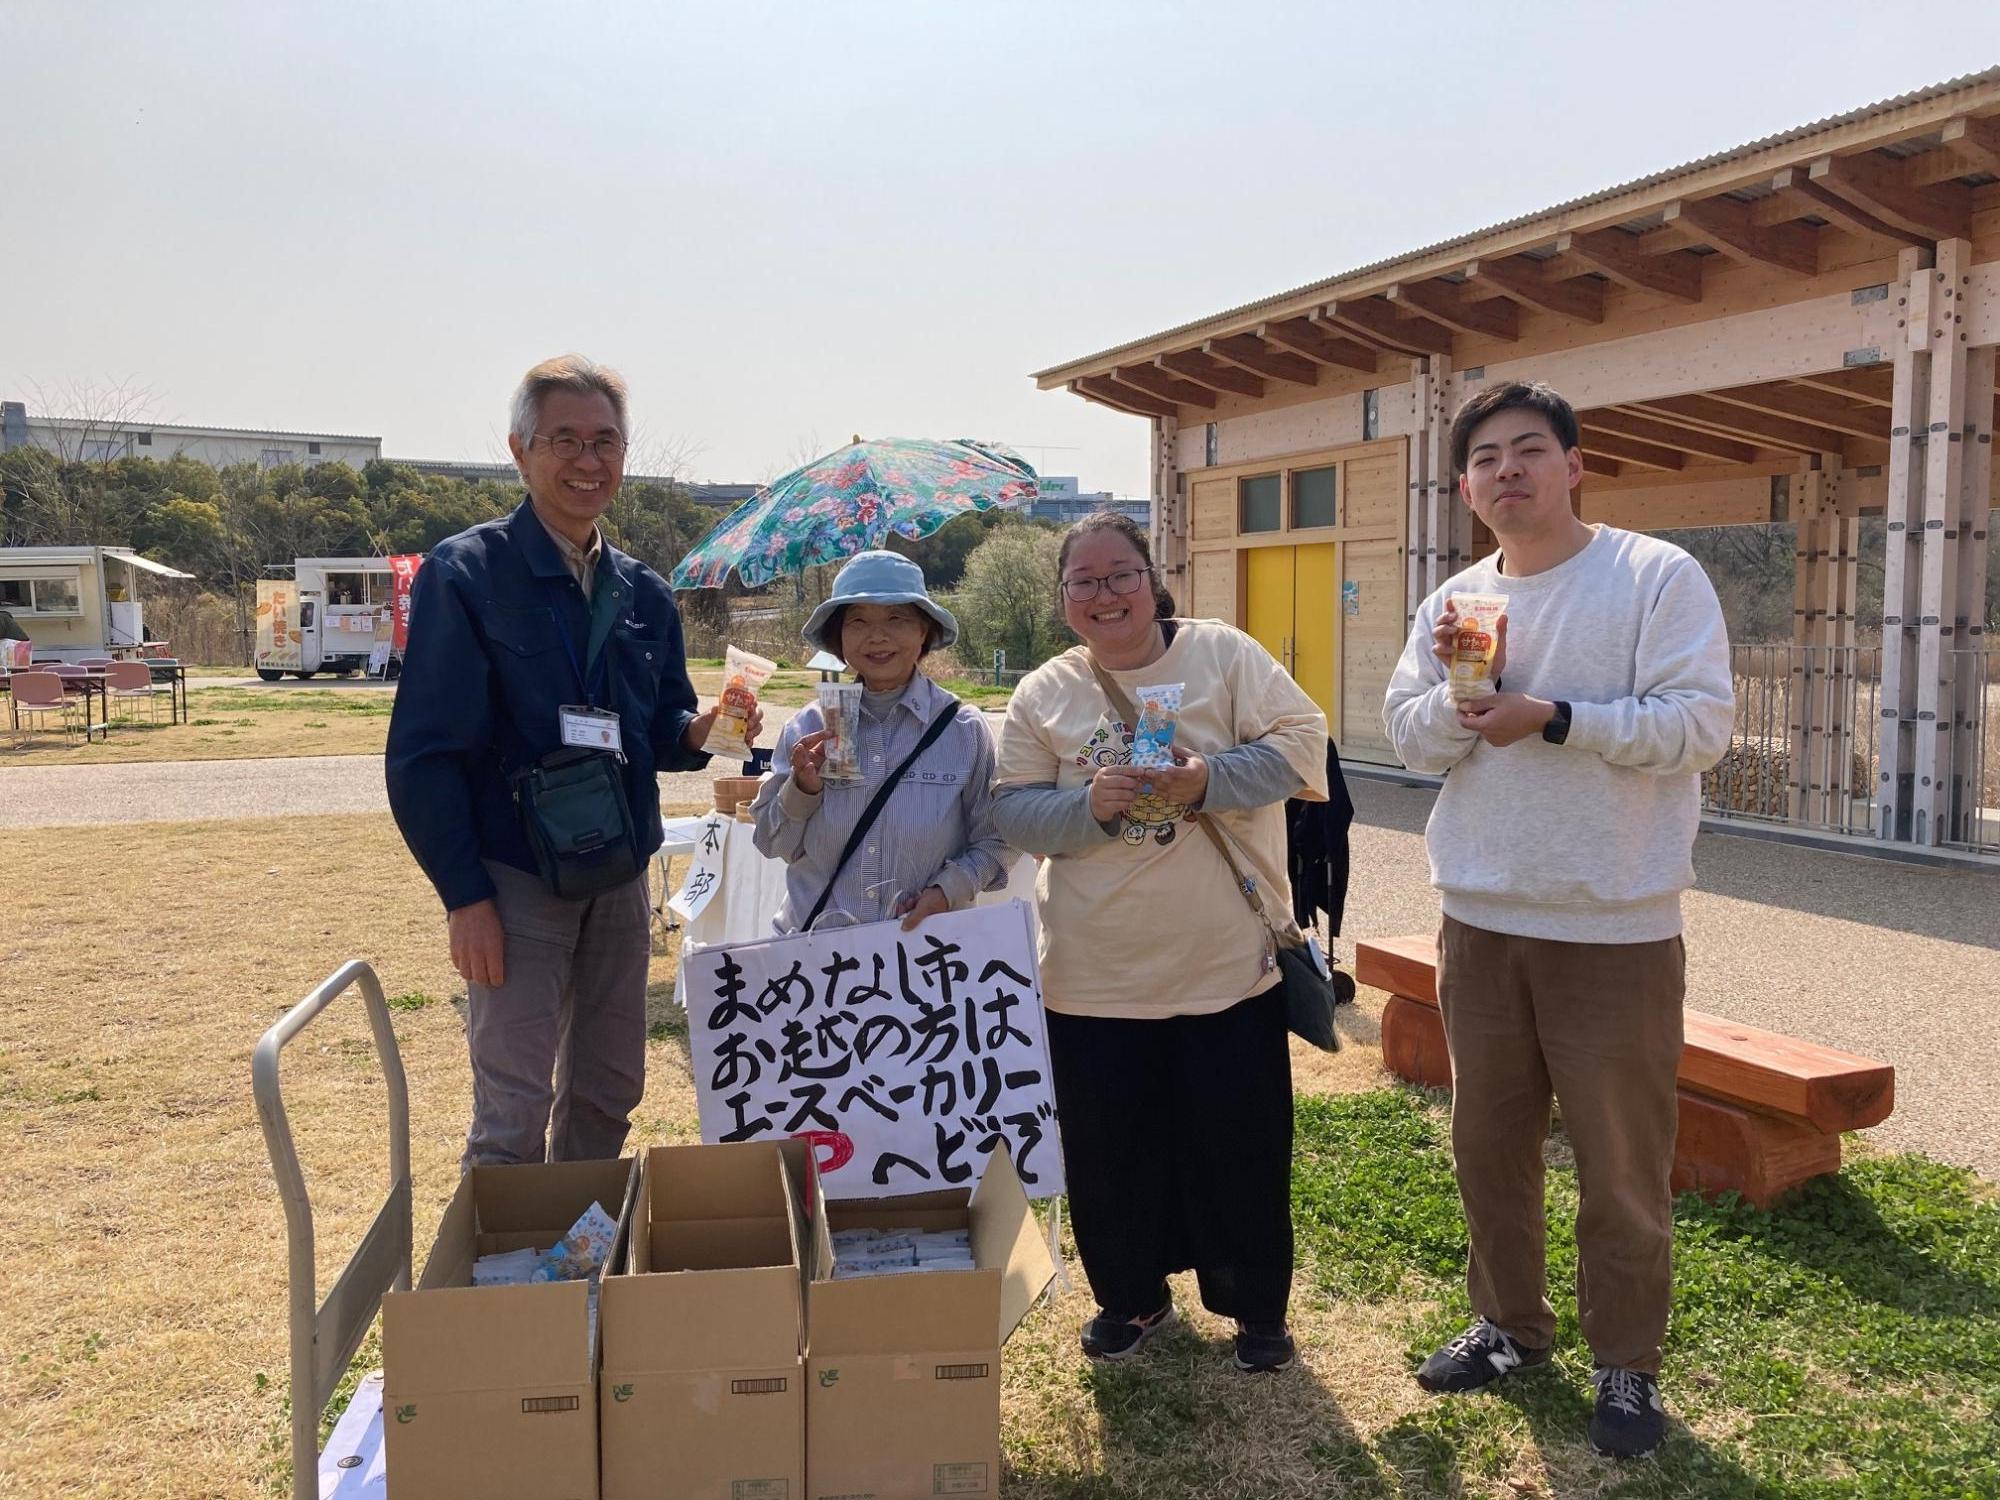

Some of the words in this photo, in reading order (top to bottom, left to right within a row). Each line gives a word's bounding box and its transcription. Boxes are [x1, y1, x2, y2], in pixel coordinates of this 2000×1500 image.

[272, 591, 288, 648] たい焼き
[684, 818, 721, 907] 本部
[707, 935, 1033, 1030] まめなし市へ
[711, 987, 1034, 1091] お越の方は
[719, 1057, 1042, 1143] エースベーカリー
